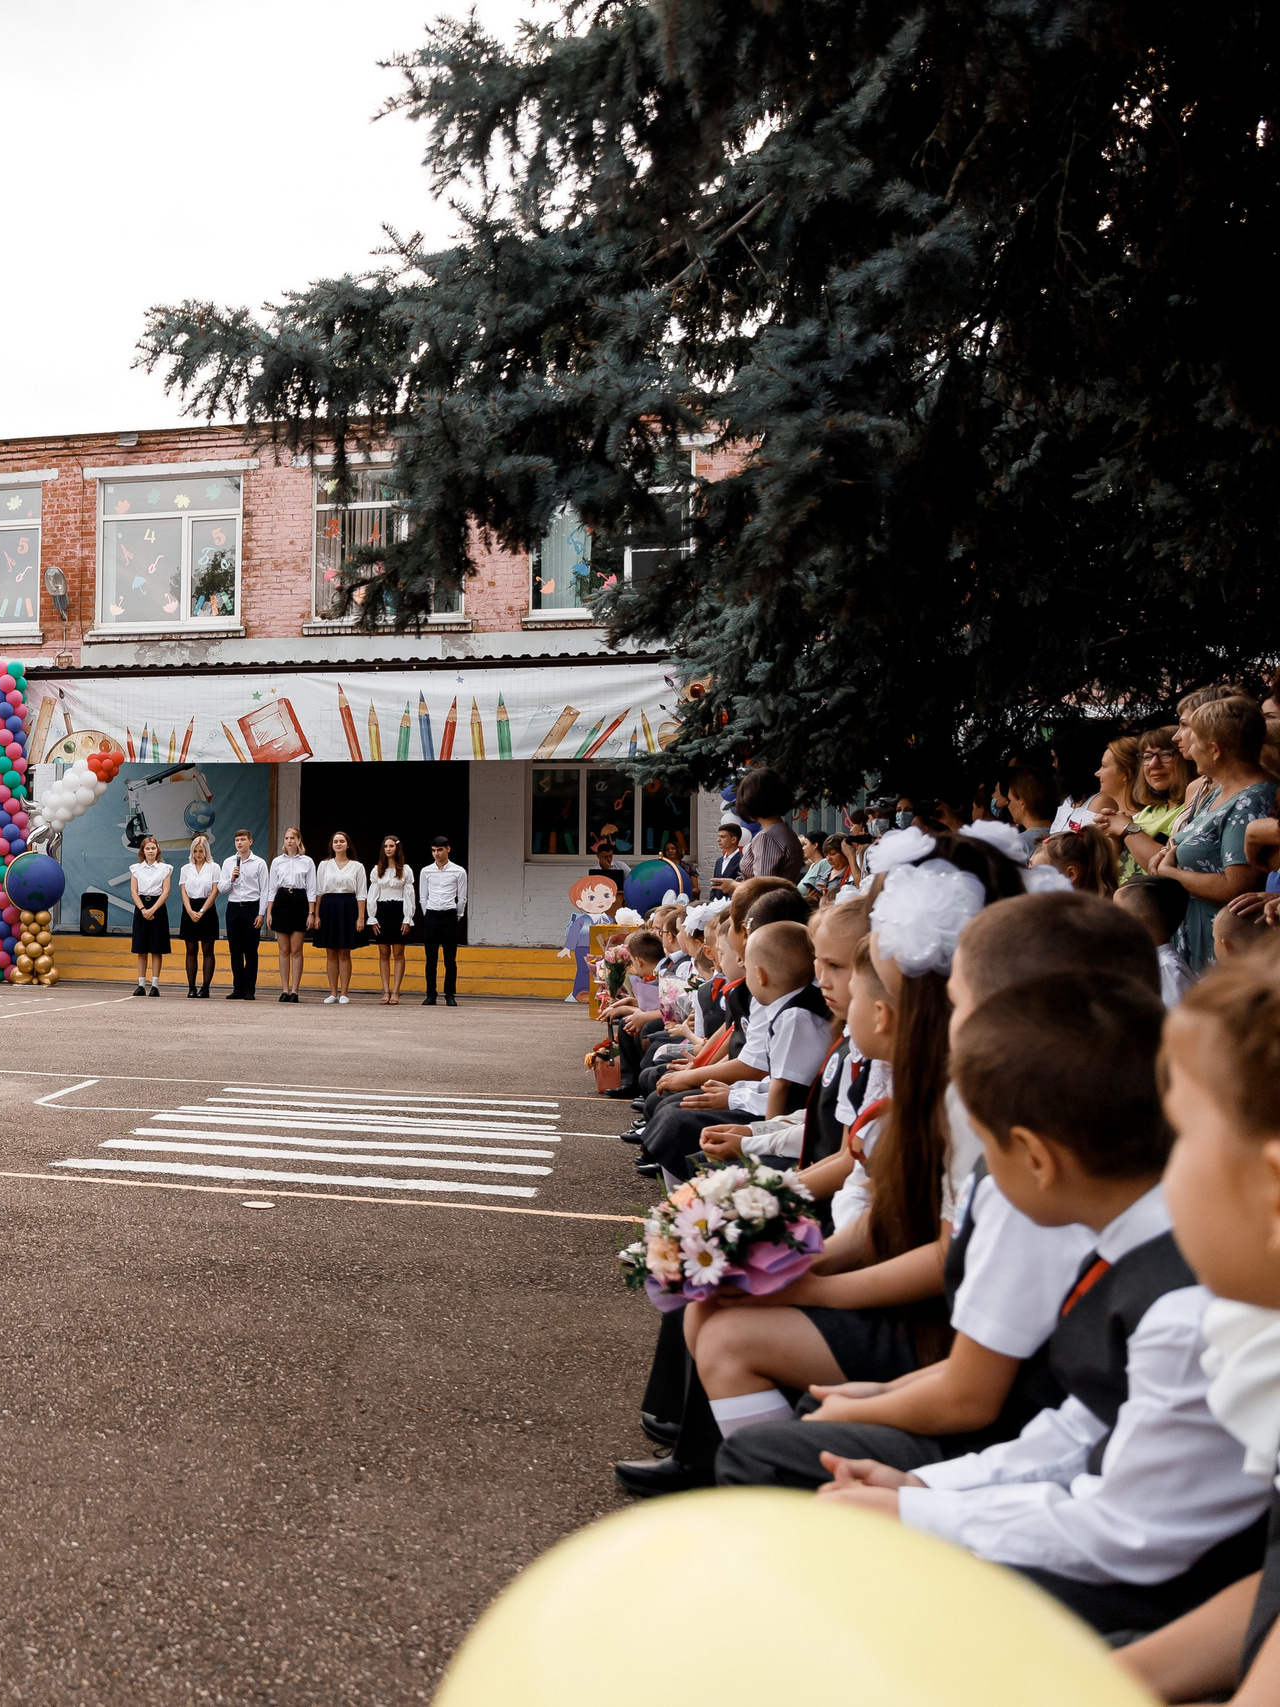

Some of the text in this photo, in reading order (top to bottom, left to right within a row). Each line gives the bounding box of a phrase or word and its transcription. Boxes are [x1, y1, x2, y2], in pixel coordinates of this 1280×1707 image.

[144, 529, 156, 543] 4
[211, 527, 226, 546] 5
[17, 537, 30, 554] 5
